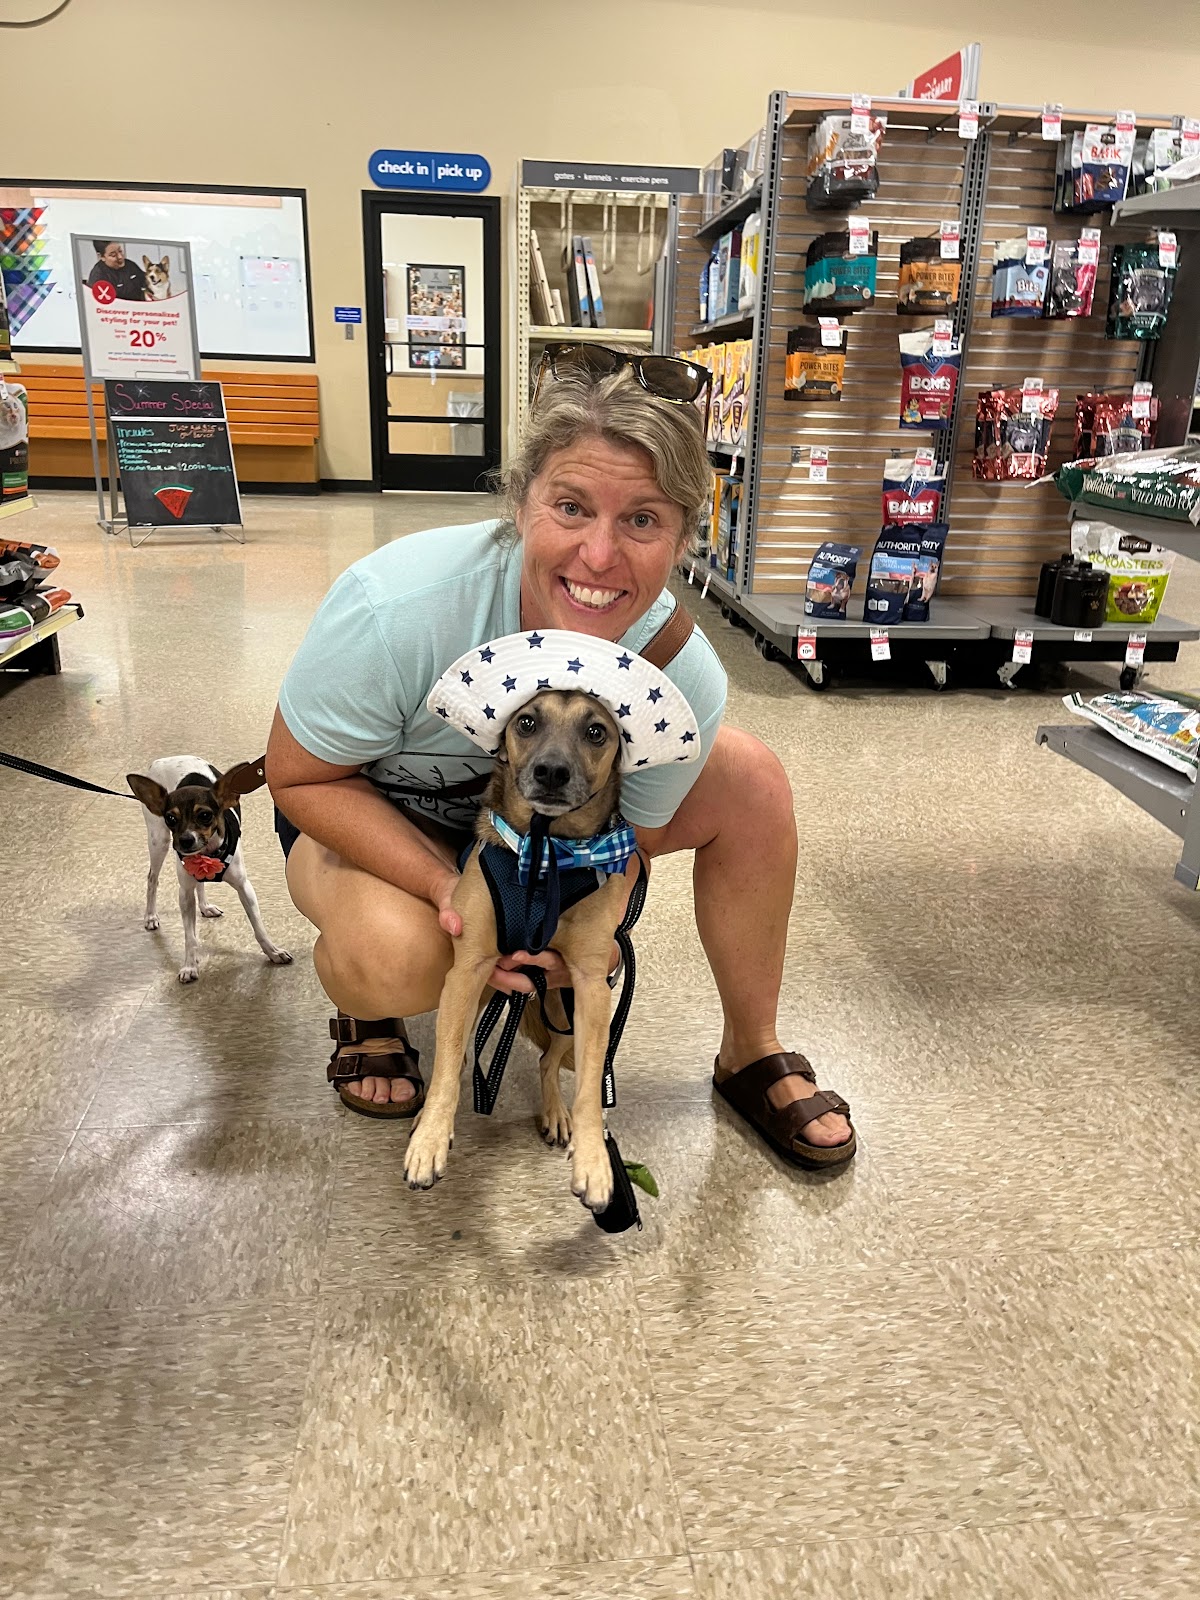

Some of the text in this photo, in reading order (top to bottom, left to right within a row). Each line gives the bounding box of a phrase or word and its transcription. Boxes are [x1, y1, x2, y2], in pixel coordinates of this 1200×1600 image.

[377, 160, 482, 181] check in pick up
[553, 172, 669, 185] gates kennels exercise pens
[830, 265, 871, 276] POWER BITES
[915, 272, 955, 281] POWER BITES
[1016, 278, 1040, 293] Bits
[96, 307, 180, 318] Discover personalized
[100, 317, 128, 325] styling
[129, 330, 167, 347] 20%
[800, 362, 840, 371] POWER BITES
[910, 376, 951, 391] BONES
[114, 383, 214, 415] Summer Special
[1130, 488, 1154, 505] WILD
[1153, 492, 1177, 509] BIRD
[888, 499, 934, 515] BONES
[877, 541, 921, 552] AUTHORITY
[816, 551, 851, 565] AUTHORITY
[1105, 557, 1164, 570] ROASTERS
